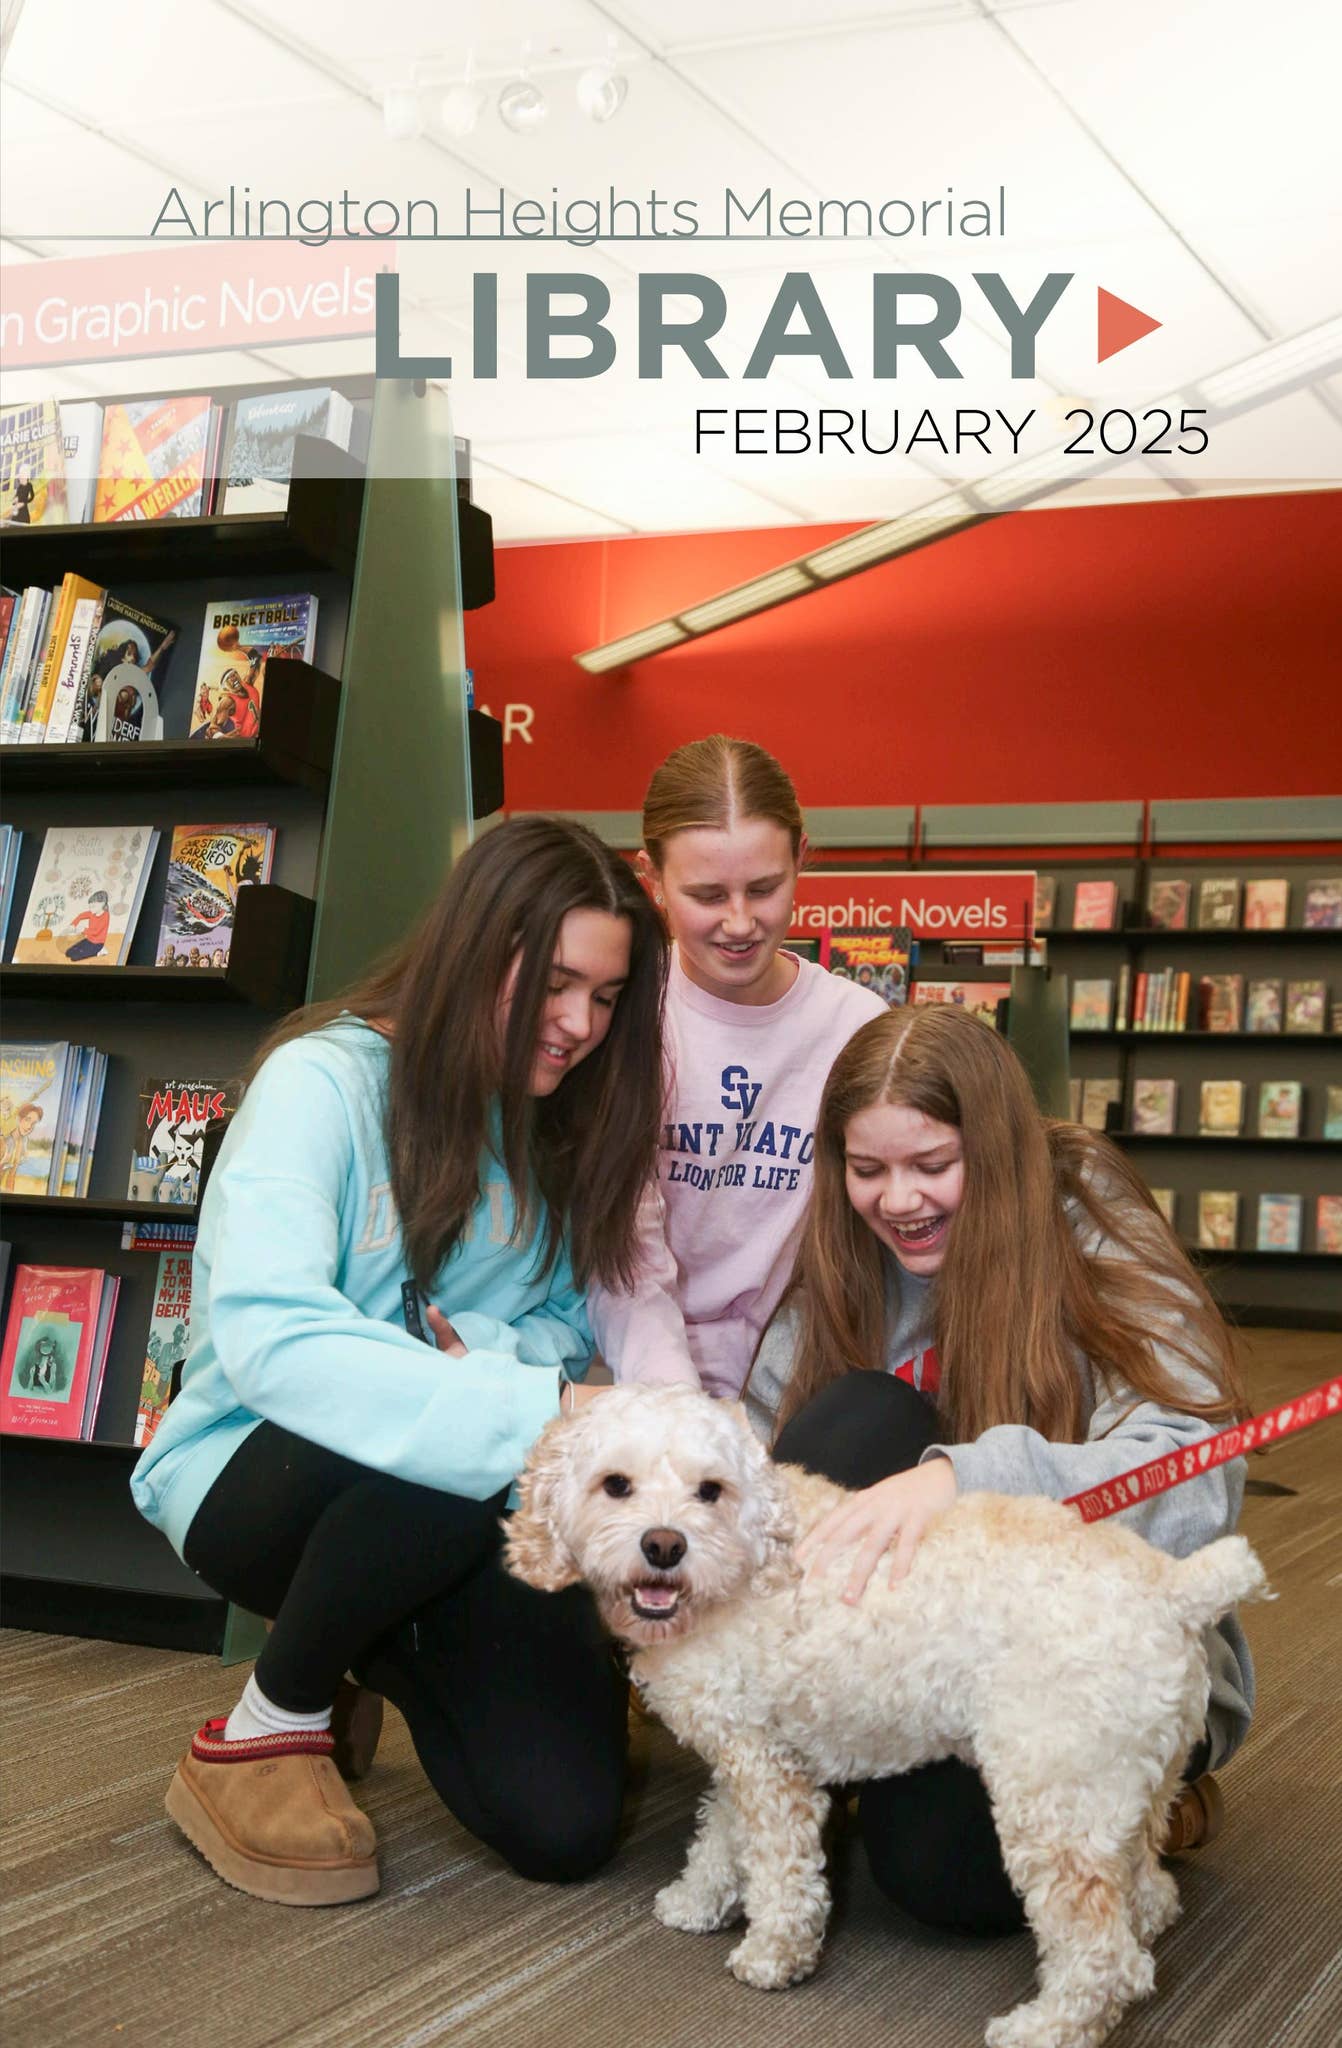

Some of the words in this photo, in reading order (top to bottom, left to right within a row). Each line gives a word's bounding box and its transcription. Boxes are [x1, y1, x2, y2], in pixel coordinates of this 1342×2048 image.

[35, 285, 207, 348] Graphic
[219, 265, 376, 328] Novels
[118, 463, 200, 520] NAMERICA
[213, 607, 299, 629] BASKETBALL
[62, 633, 81, 690] Spinning
[180, 847, 226, 866] CARRIED
[200, 838, 237, 857] STORIES
[188, 857, 210, 875] HERE
[900, 897, 1008, 928] Novels
[146, 1090, 226, 1129] MAUS
[660, 1123, 724, 1157] INT
[668, 1160, 716, 1191] LION
[715, 1163, 747, 1189] FOR
[752, 1165, 800, 1191] LIFE
[159, 1288, 175, 1302] MY
[1083, 1494, 1105, 1519] ATD
[1143, 1463, 1166, 1492] ATD
[1212, 1429, 1240, 1460] ATD
